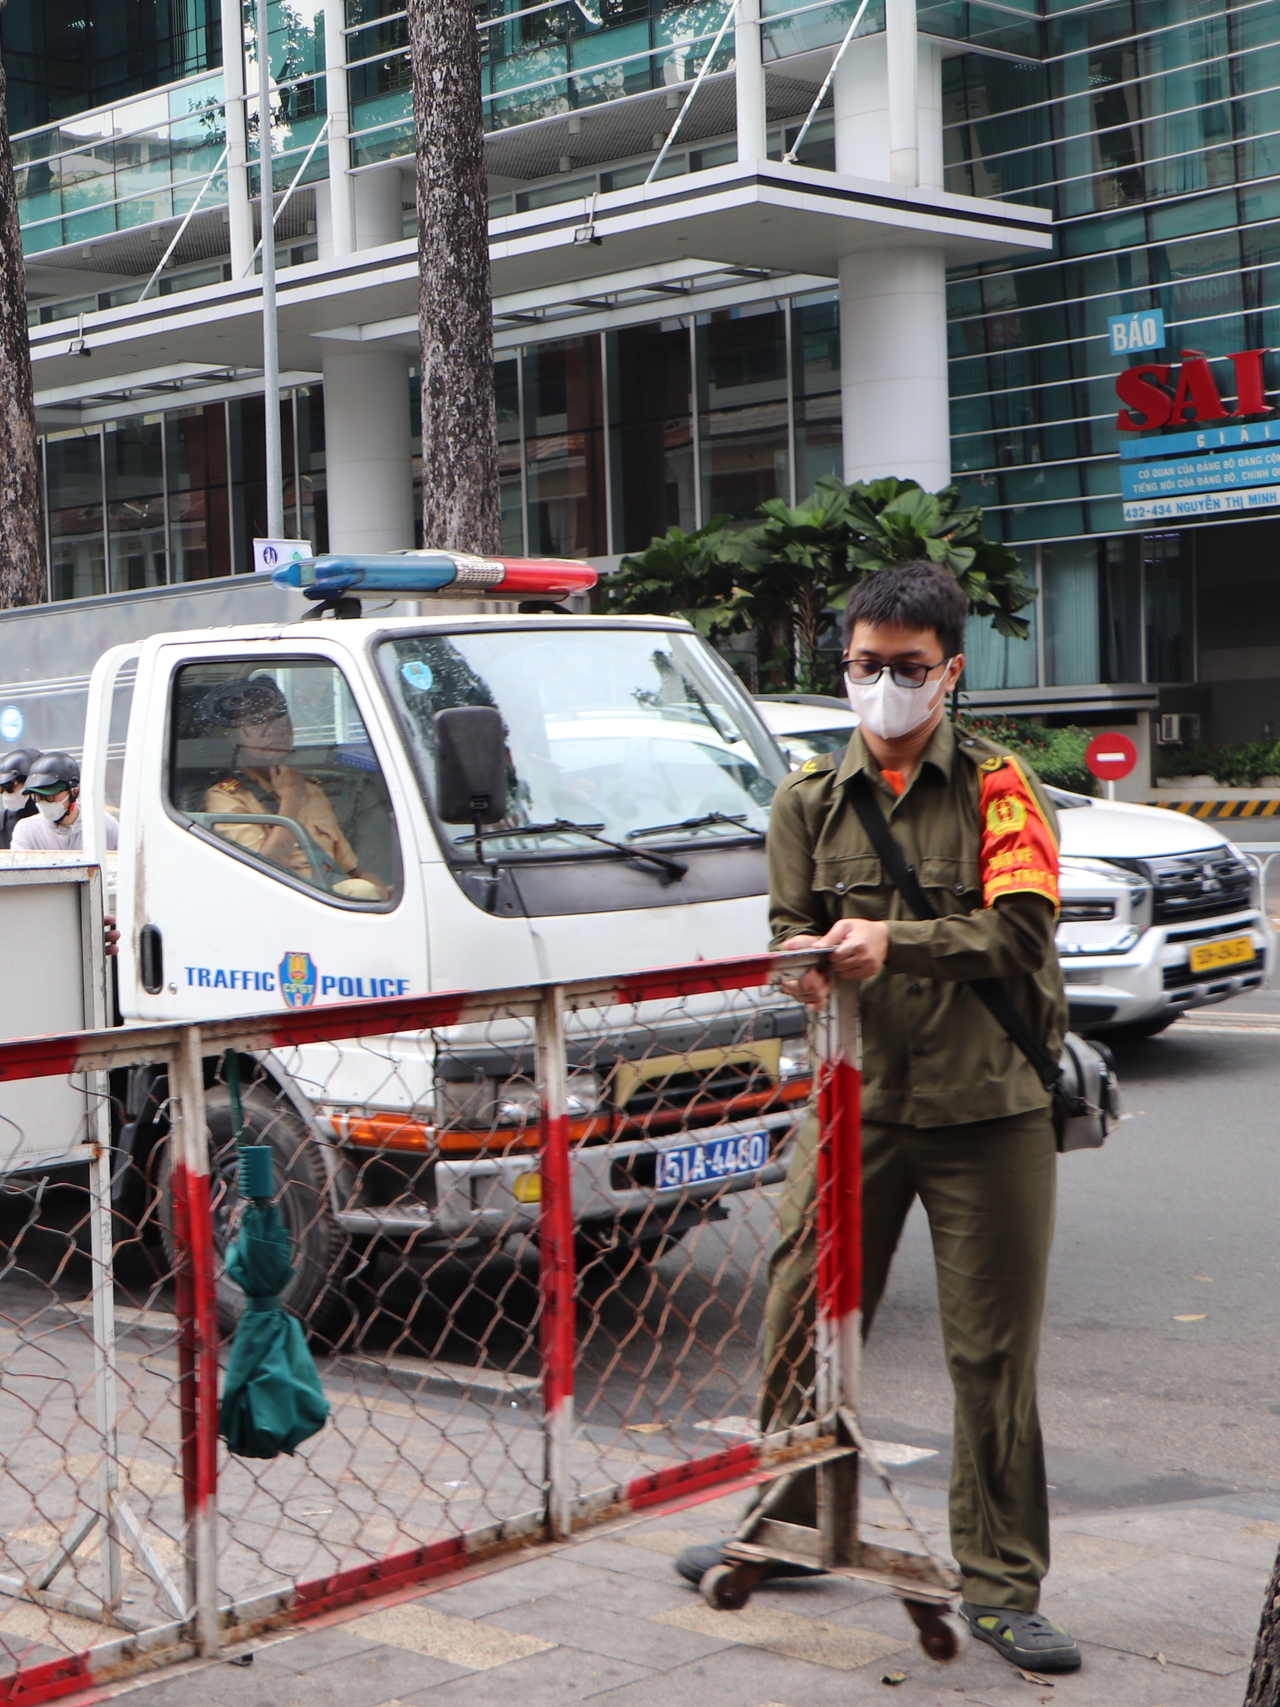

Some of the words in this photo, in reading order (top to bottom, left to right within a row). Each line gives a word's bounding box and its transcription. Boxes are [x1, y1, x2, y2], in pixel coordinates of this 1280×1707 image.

[1112, 314, 1157, 351] BÁO
[1115, 348, 1274, 431] SÀI
[1152, 466, 1175, 477] QUAN
[1223, 458, 1235, 469] BỘ
[1132, 481, 1158, 494] TIẾNG
[1160, 479, 1175, 491] NÓI
[1241, 469, 1269, 481] CHÍNH
[1125, 503, 1172, 519] 432-434
[1176, 494, 1221, 514] NGUYỄN
[1225, 496, 1244, 511] THỊ
[1248, 492, 1278, 506] MINH
[184, 966, 275, 992] TRAFFIC
[322, 975, 411, 998] POLICE
[664, 1135, 764, 1185] 51A-4480
